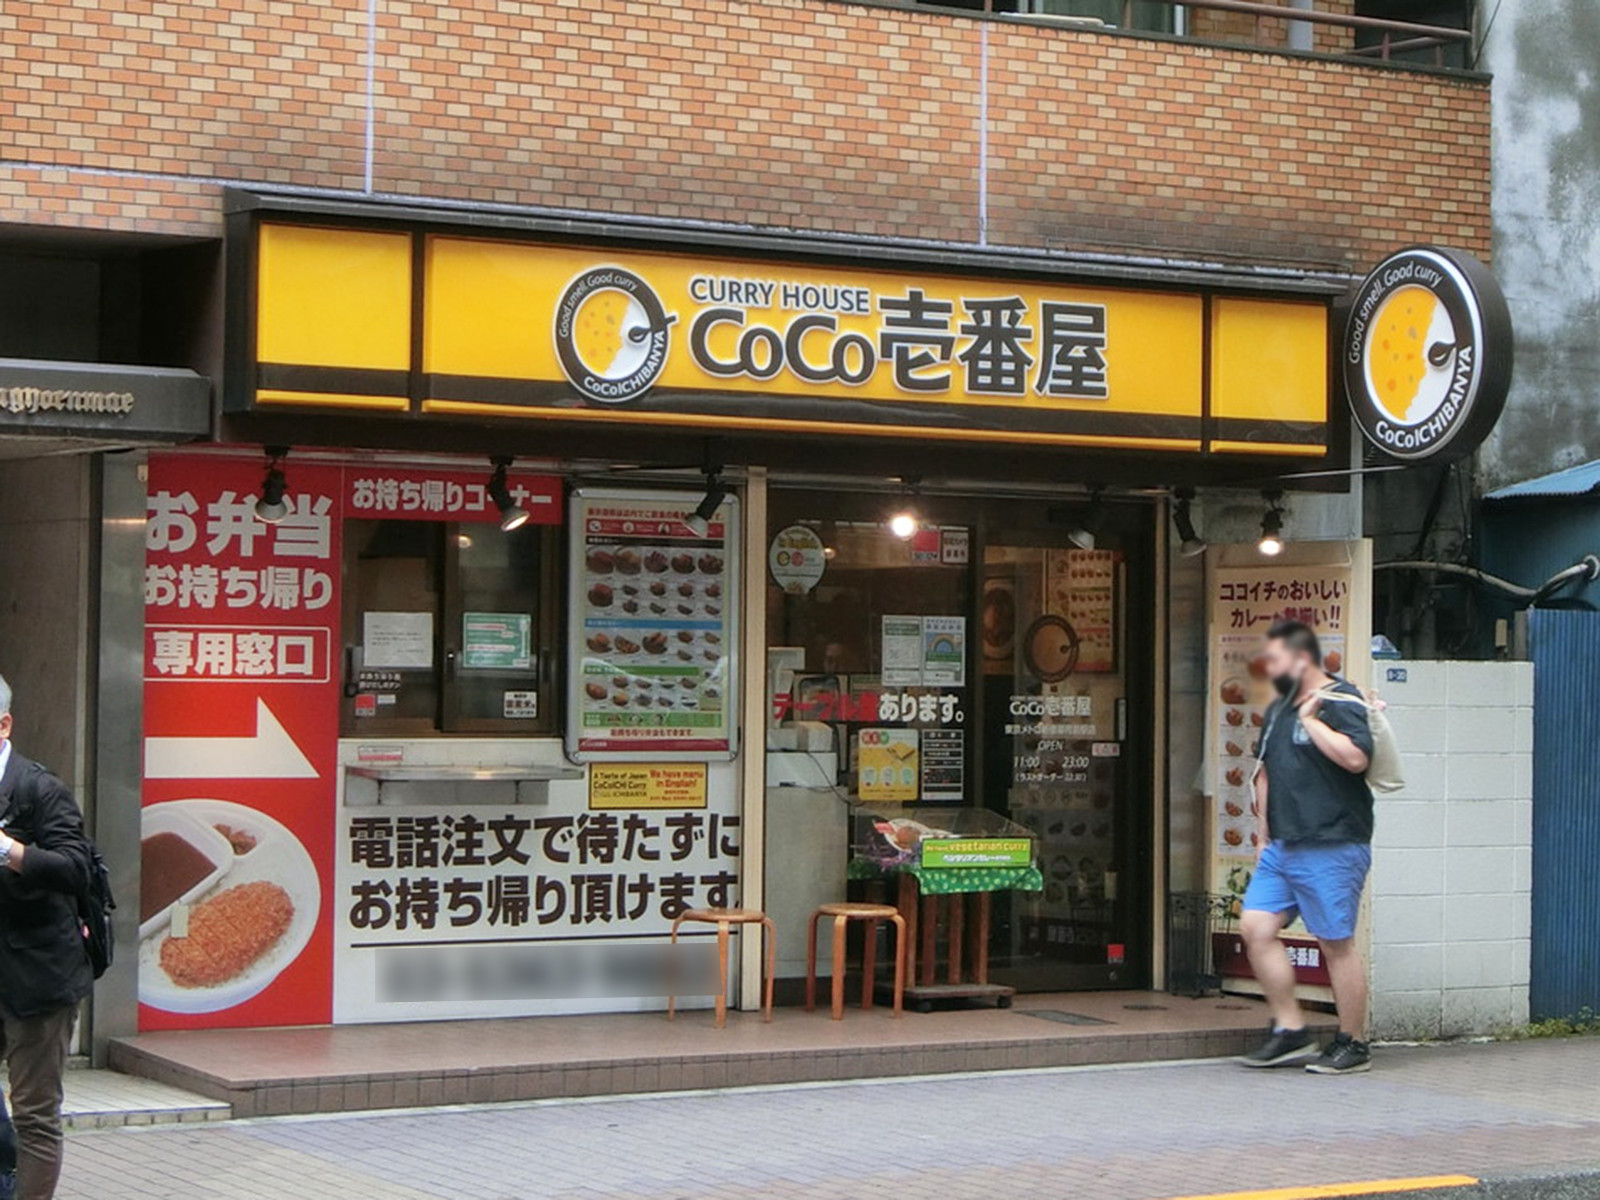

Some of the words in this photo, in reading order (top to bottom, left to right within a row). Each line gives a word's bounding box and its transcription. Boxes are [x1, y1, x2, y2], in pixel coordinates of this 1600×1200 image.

[560, 305, 572, 338] Good
[586, 272, 613, 287] Good
[614, 275, 638, 292] curry
[690, 277, 775, 304] CURRY
[783, 284, 870, 313] HOUSE
[1349, 318, 1365, 364] Good
[1384, 260, 1415, 288] Good
[1414, 264, 1444, 289] curry
[584, 330, 665, 396] CoCoICHIBANYA
[690, 288, 1108, 398] CoCo壱番屋
[1375, 345, 1473, 449] CoCoICHIBANYA
[352, 477, 553, 512] お持ち帰りコナー
[146, 489, 333, 559] お弁当
[144, 563, 333, 610] お持ち帰り
[1220, 579, 1347, 602] ココイチのおいしい
[152, 631, 314, 676] 専用窓口
[1014, 756, 1040, 768] 11:00
[1062, 756, 1090, 768] 23:00
[1037, 741, 1064, 751] OPEN
[349, 813, 741, 869] 電話注文で待たずに
[950, 841, 1002, 852] vegetarian
[1003, 842, 1028, 851] curry
